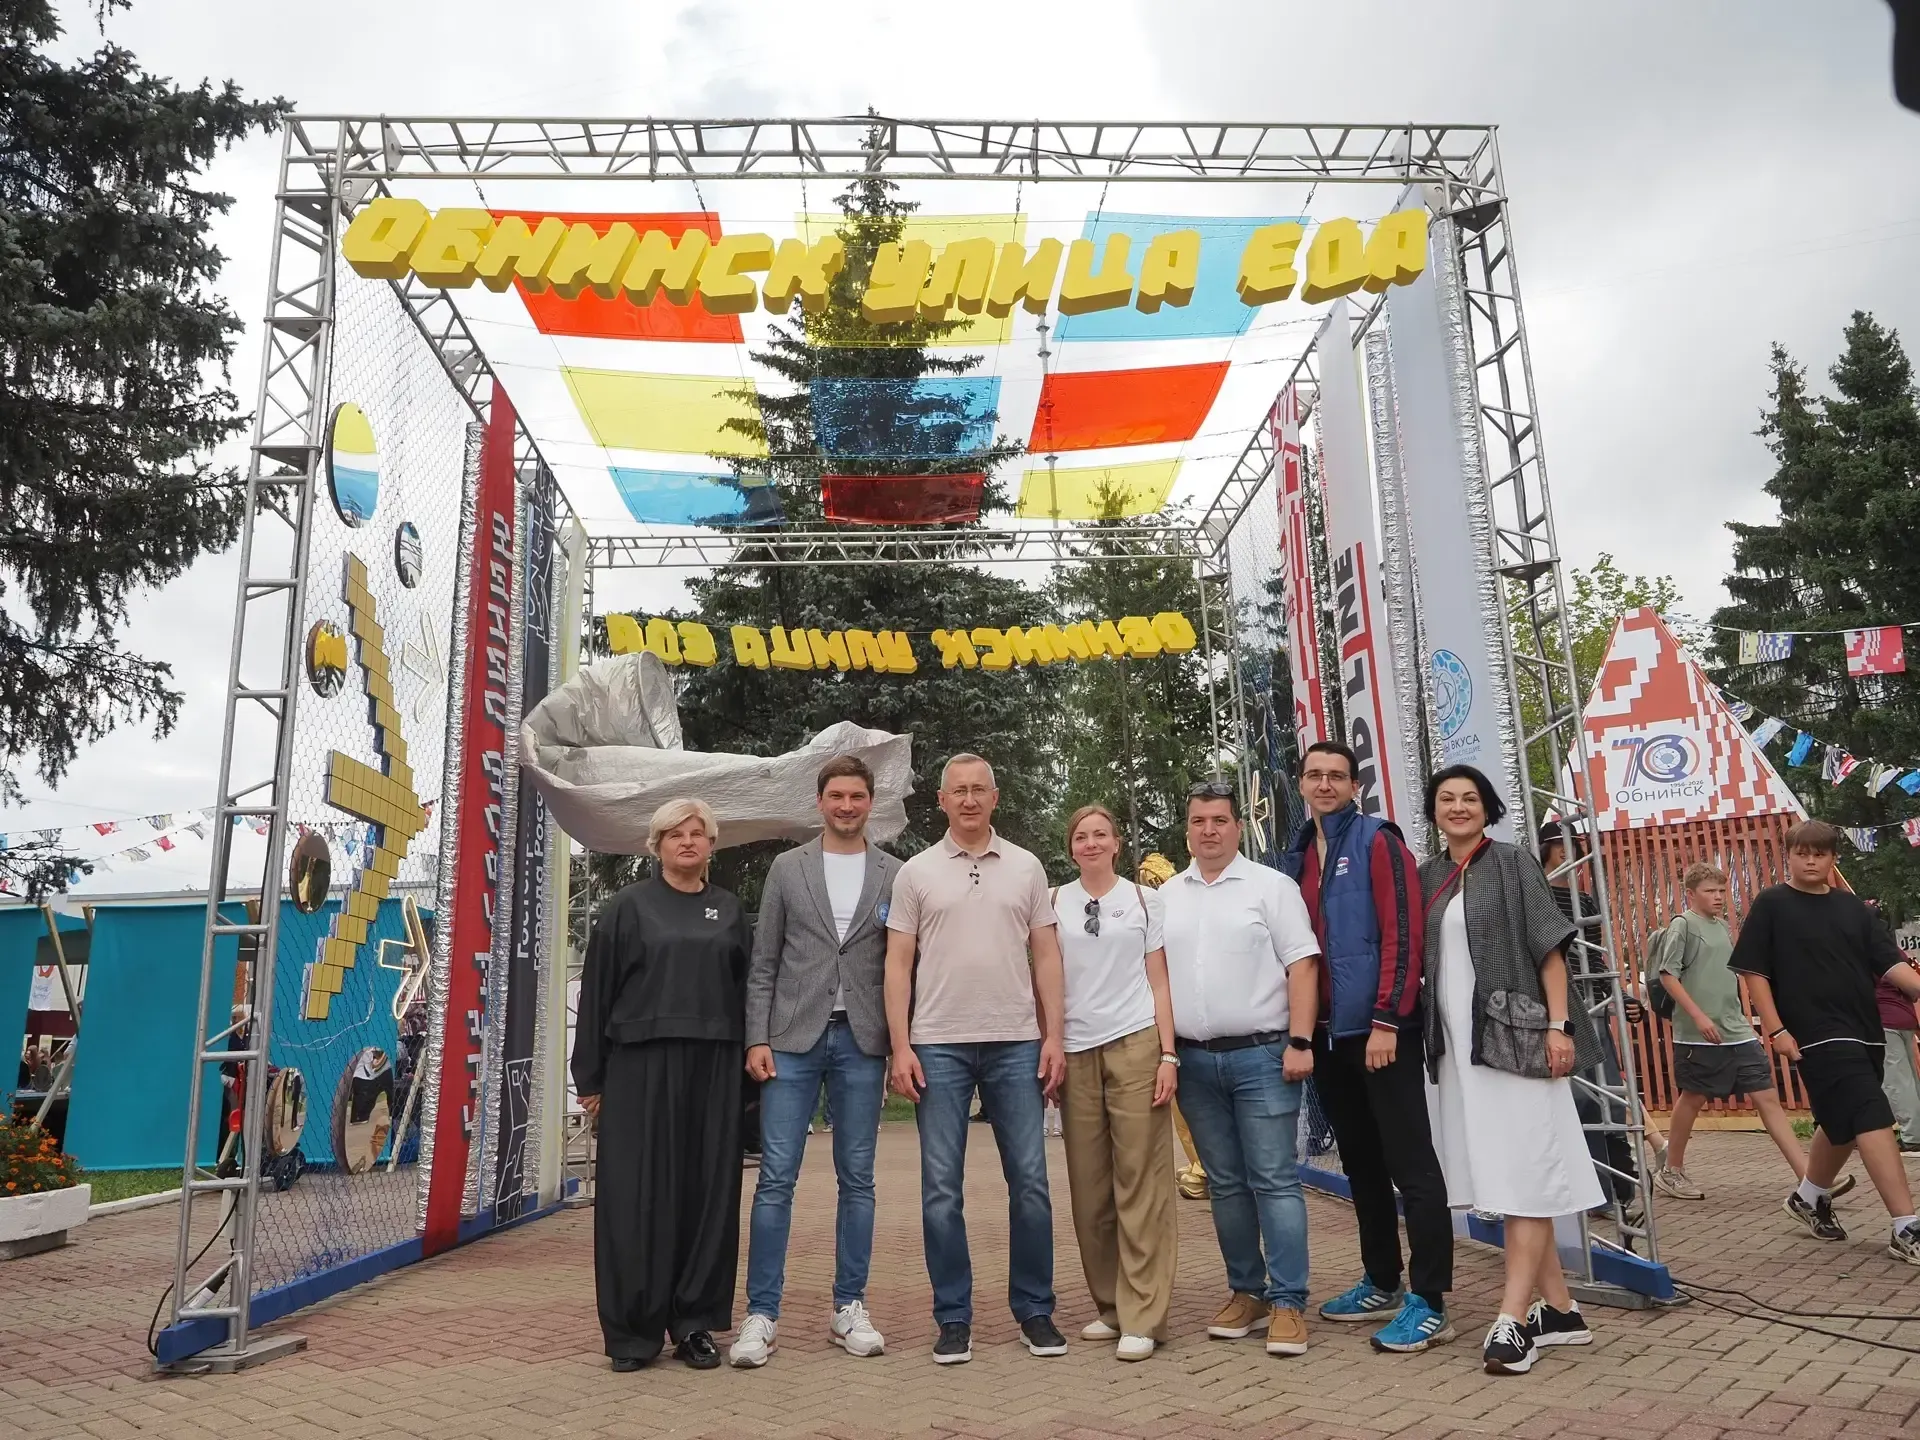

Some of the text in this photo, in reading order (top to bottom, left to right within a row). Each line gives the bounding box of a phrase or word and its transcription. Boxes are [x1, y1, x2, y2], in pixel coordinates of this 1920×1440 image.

[342, 197, 1427, 324] ОБНИНСК УЛИЦА ЕДА
[1334, 547, 1369, 700] LINE
[1451, 734, 1480, 750] ВКУСА
[1616, 785, 1705, 804] Обнинск
